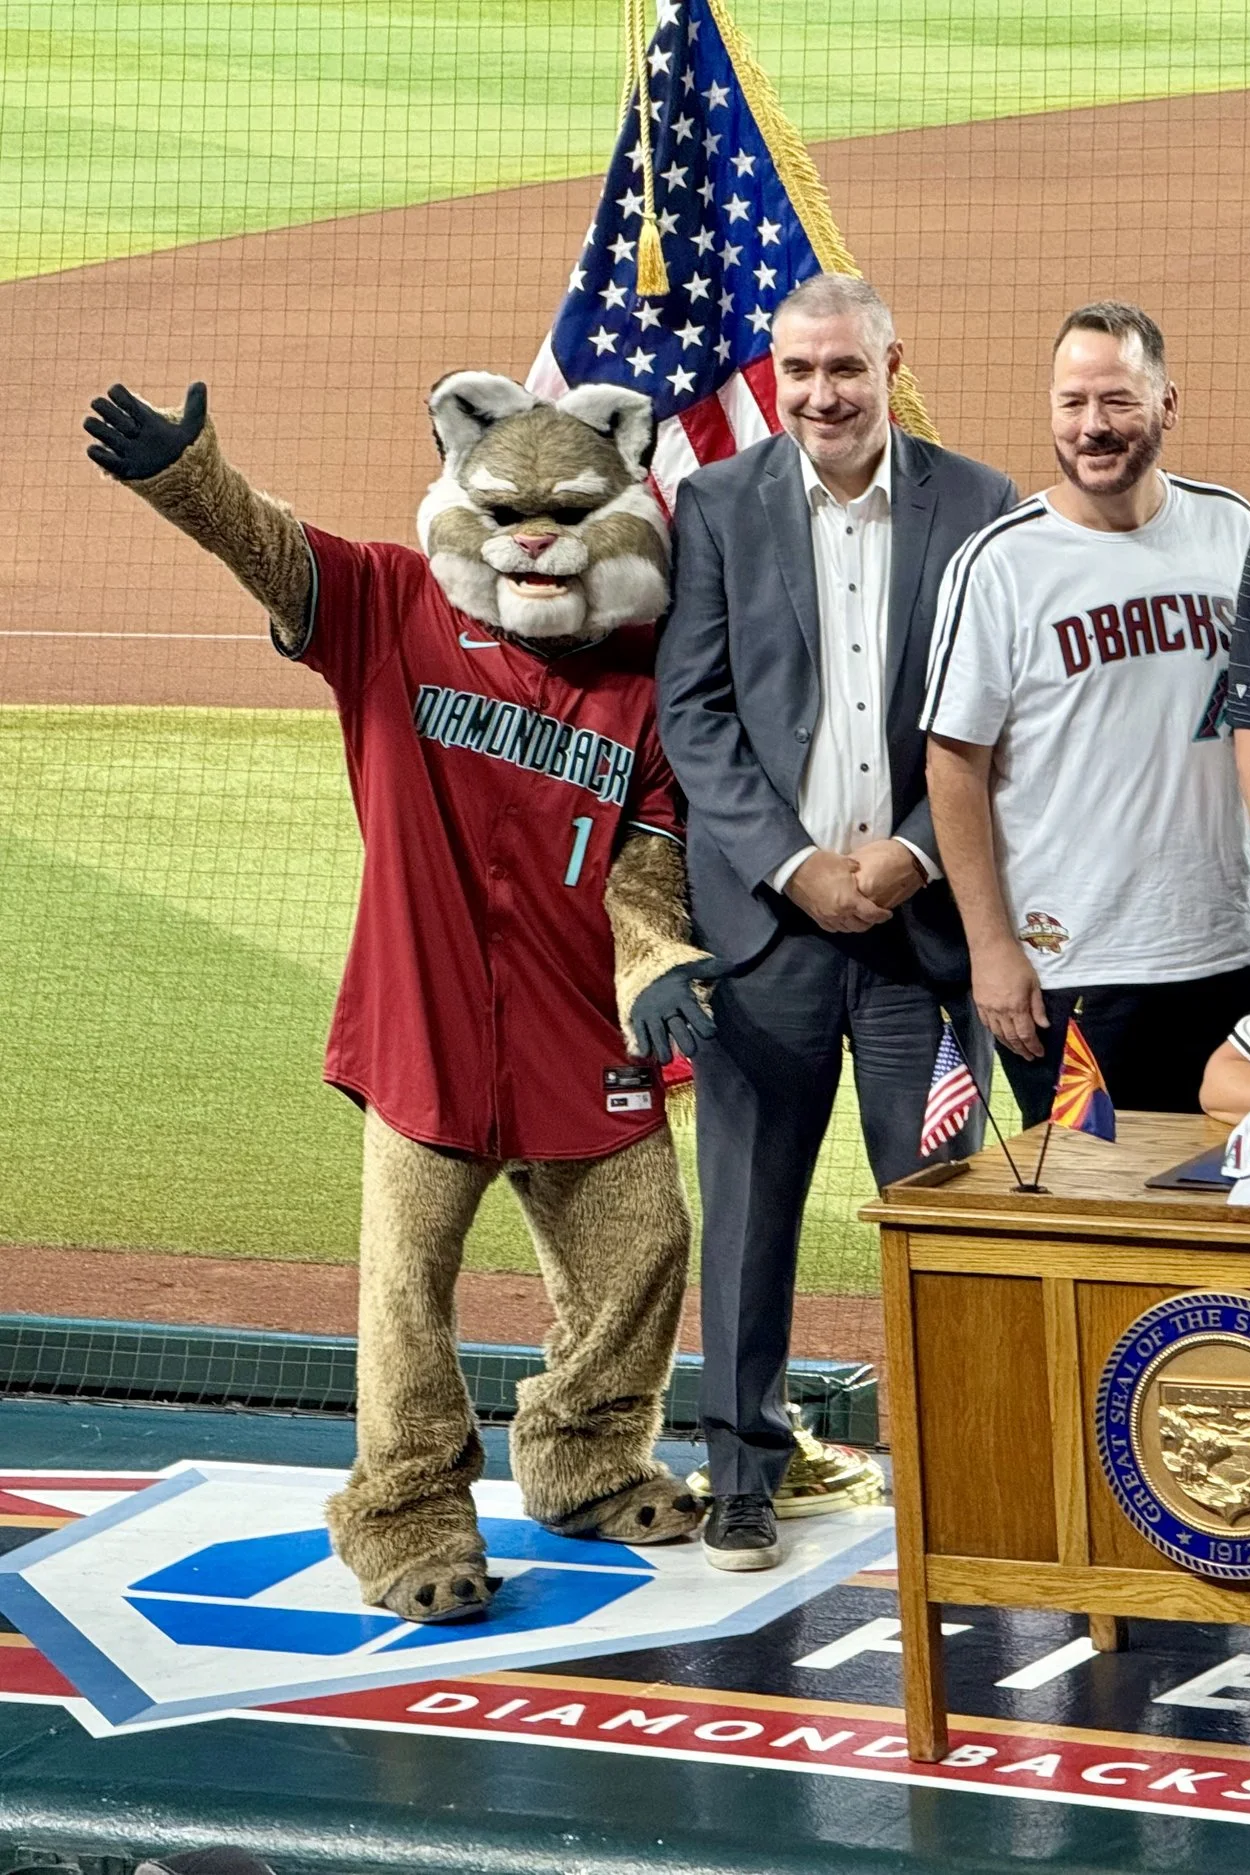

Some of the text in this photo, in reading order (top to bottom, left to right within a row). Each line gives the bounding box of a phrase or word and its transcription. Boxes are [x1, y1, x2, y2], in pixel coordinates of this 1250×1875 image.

[413, 684, 635, 807] DIAMONDBACK
[564, 816, 593, 887] 1
[1136, 1326, 1165, 1358] OF
[1169, 1309, 1222, 1333] THE
[1111, 1434, 1162, 1523] GREAT
